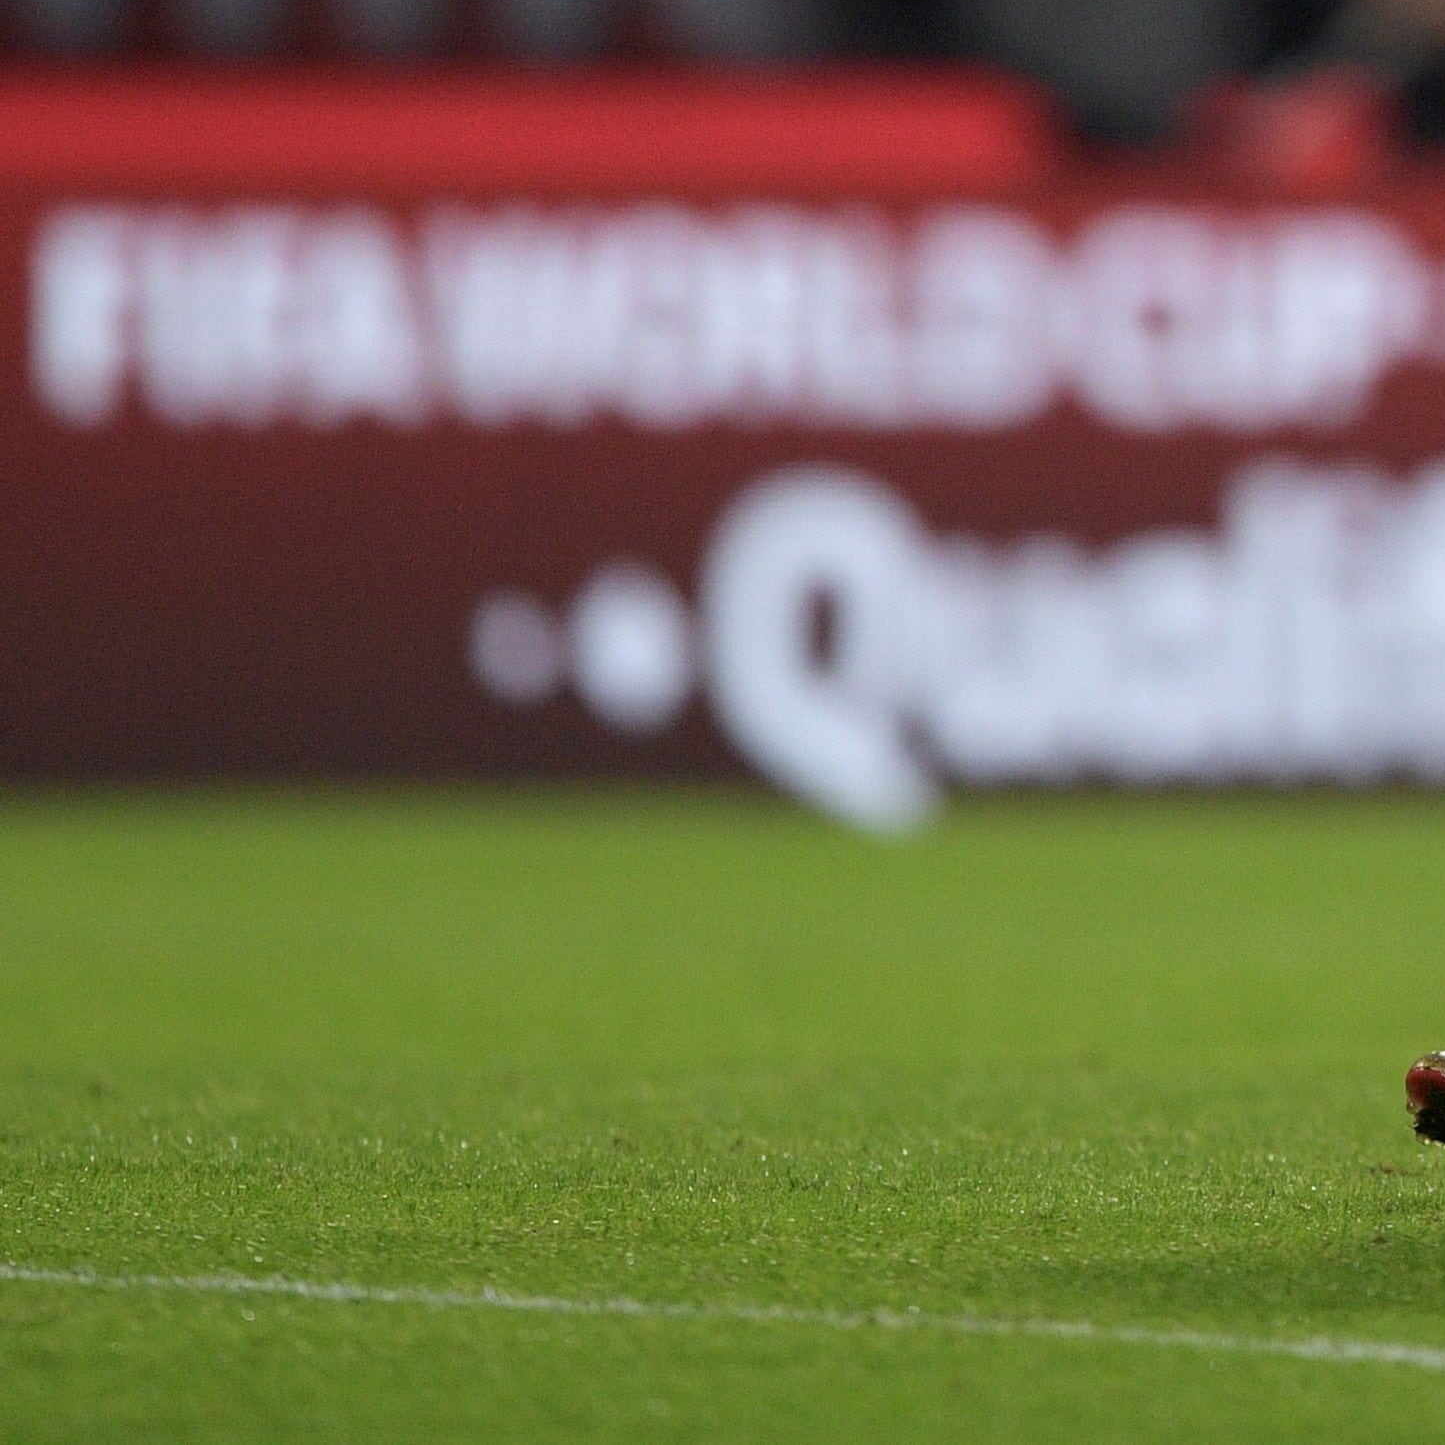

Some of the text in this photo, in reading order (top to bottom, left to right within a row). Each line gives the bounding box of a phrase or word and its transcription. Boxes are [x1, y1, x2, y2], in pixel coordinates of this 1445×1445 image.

[28, 206, 425, 426] FIFA
[428, 206, 1062, 428] WORLD
[1070, 206, 1430, 434] CUP
